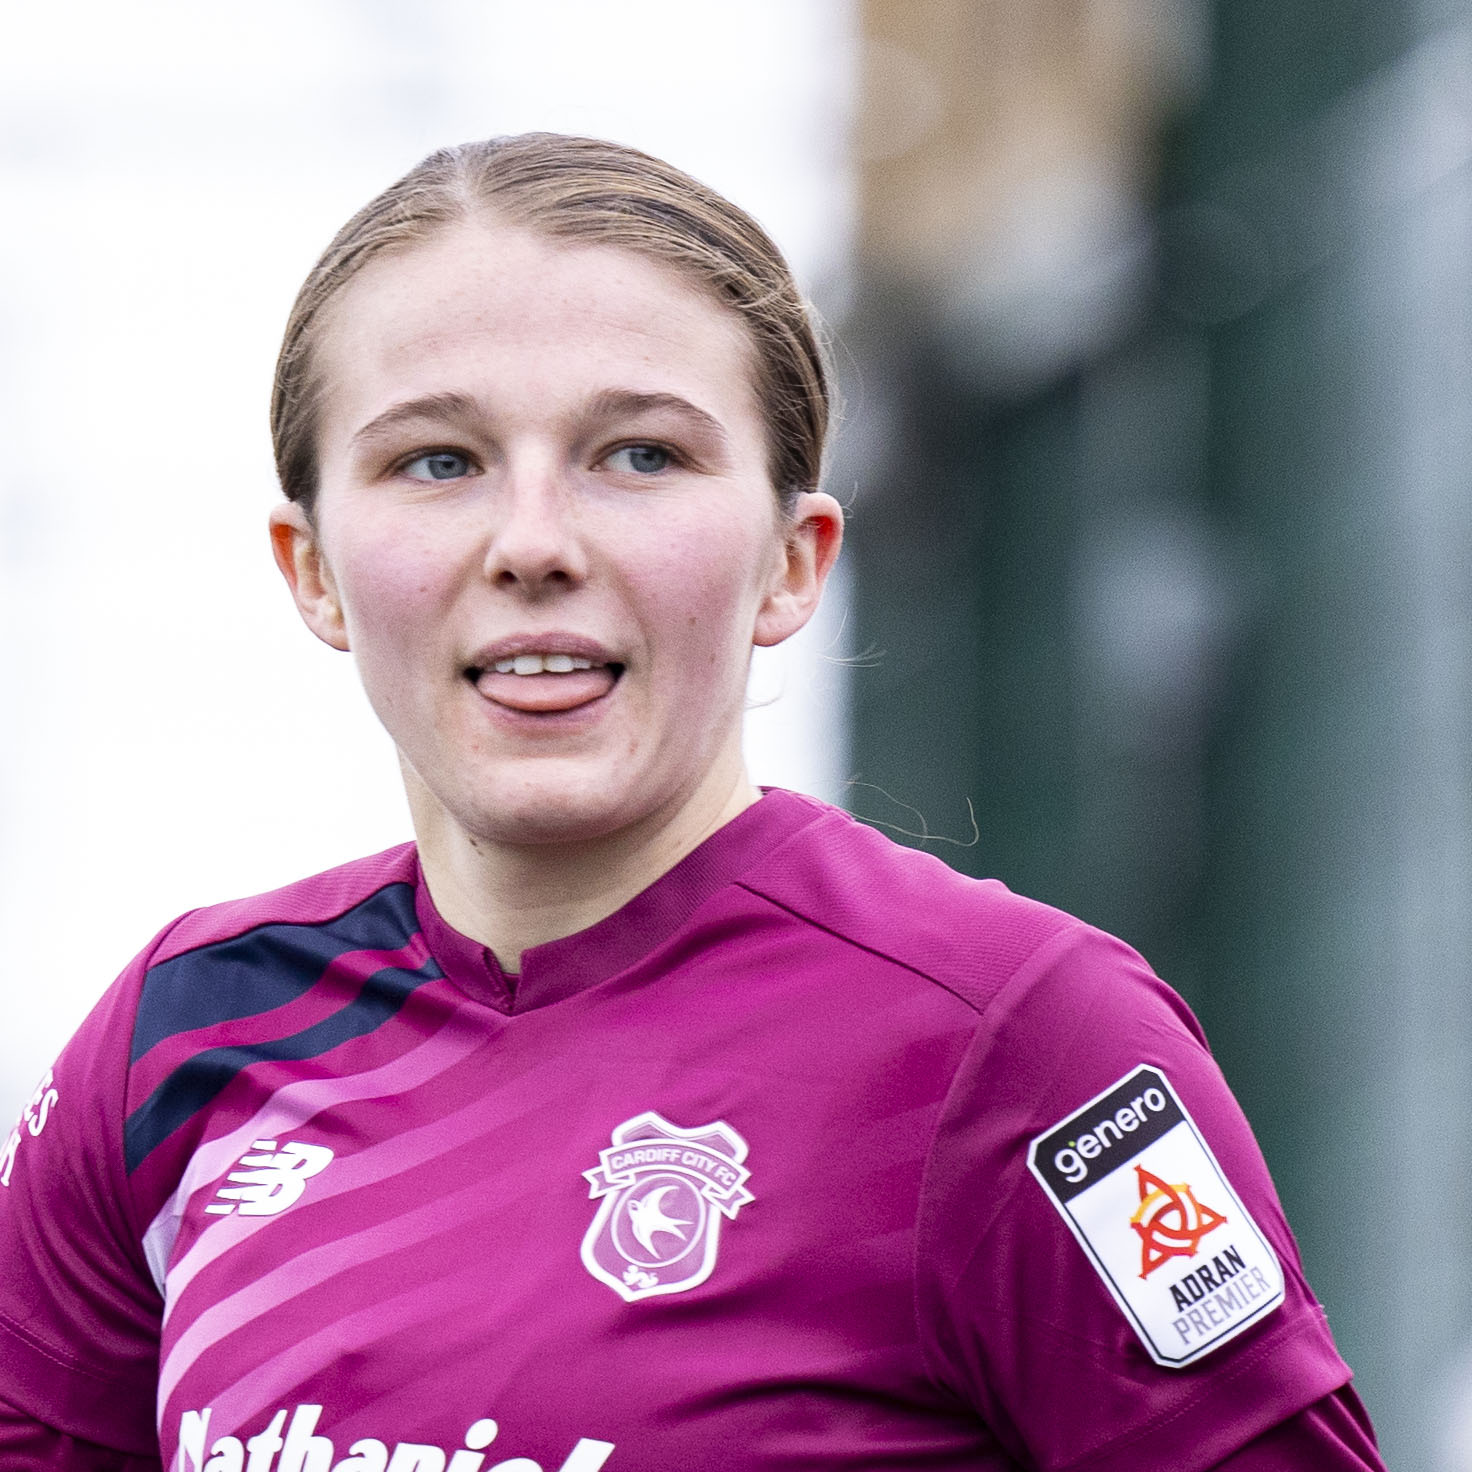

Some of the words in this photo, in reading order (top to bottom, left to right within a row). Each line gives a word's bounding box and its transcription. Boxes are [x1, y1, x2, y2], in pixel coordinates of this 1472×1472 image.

[612, 1149, 681, 1169] CARDIFF
[682, 1151, 716, 1172] CITY
[715, 1166, 736, 1187] FC
[1055, 1087, 1166, 1183] genero
[1169, 1245, 1246, 1313] ADRAN
[1172, 1267, 1270, 1345] PREMIER
